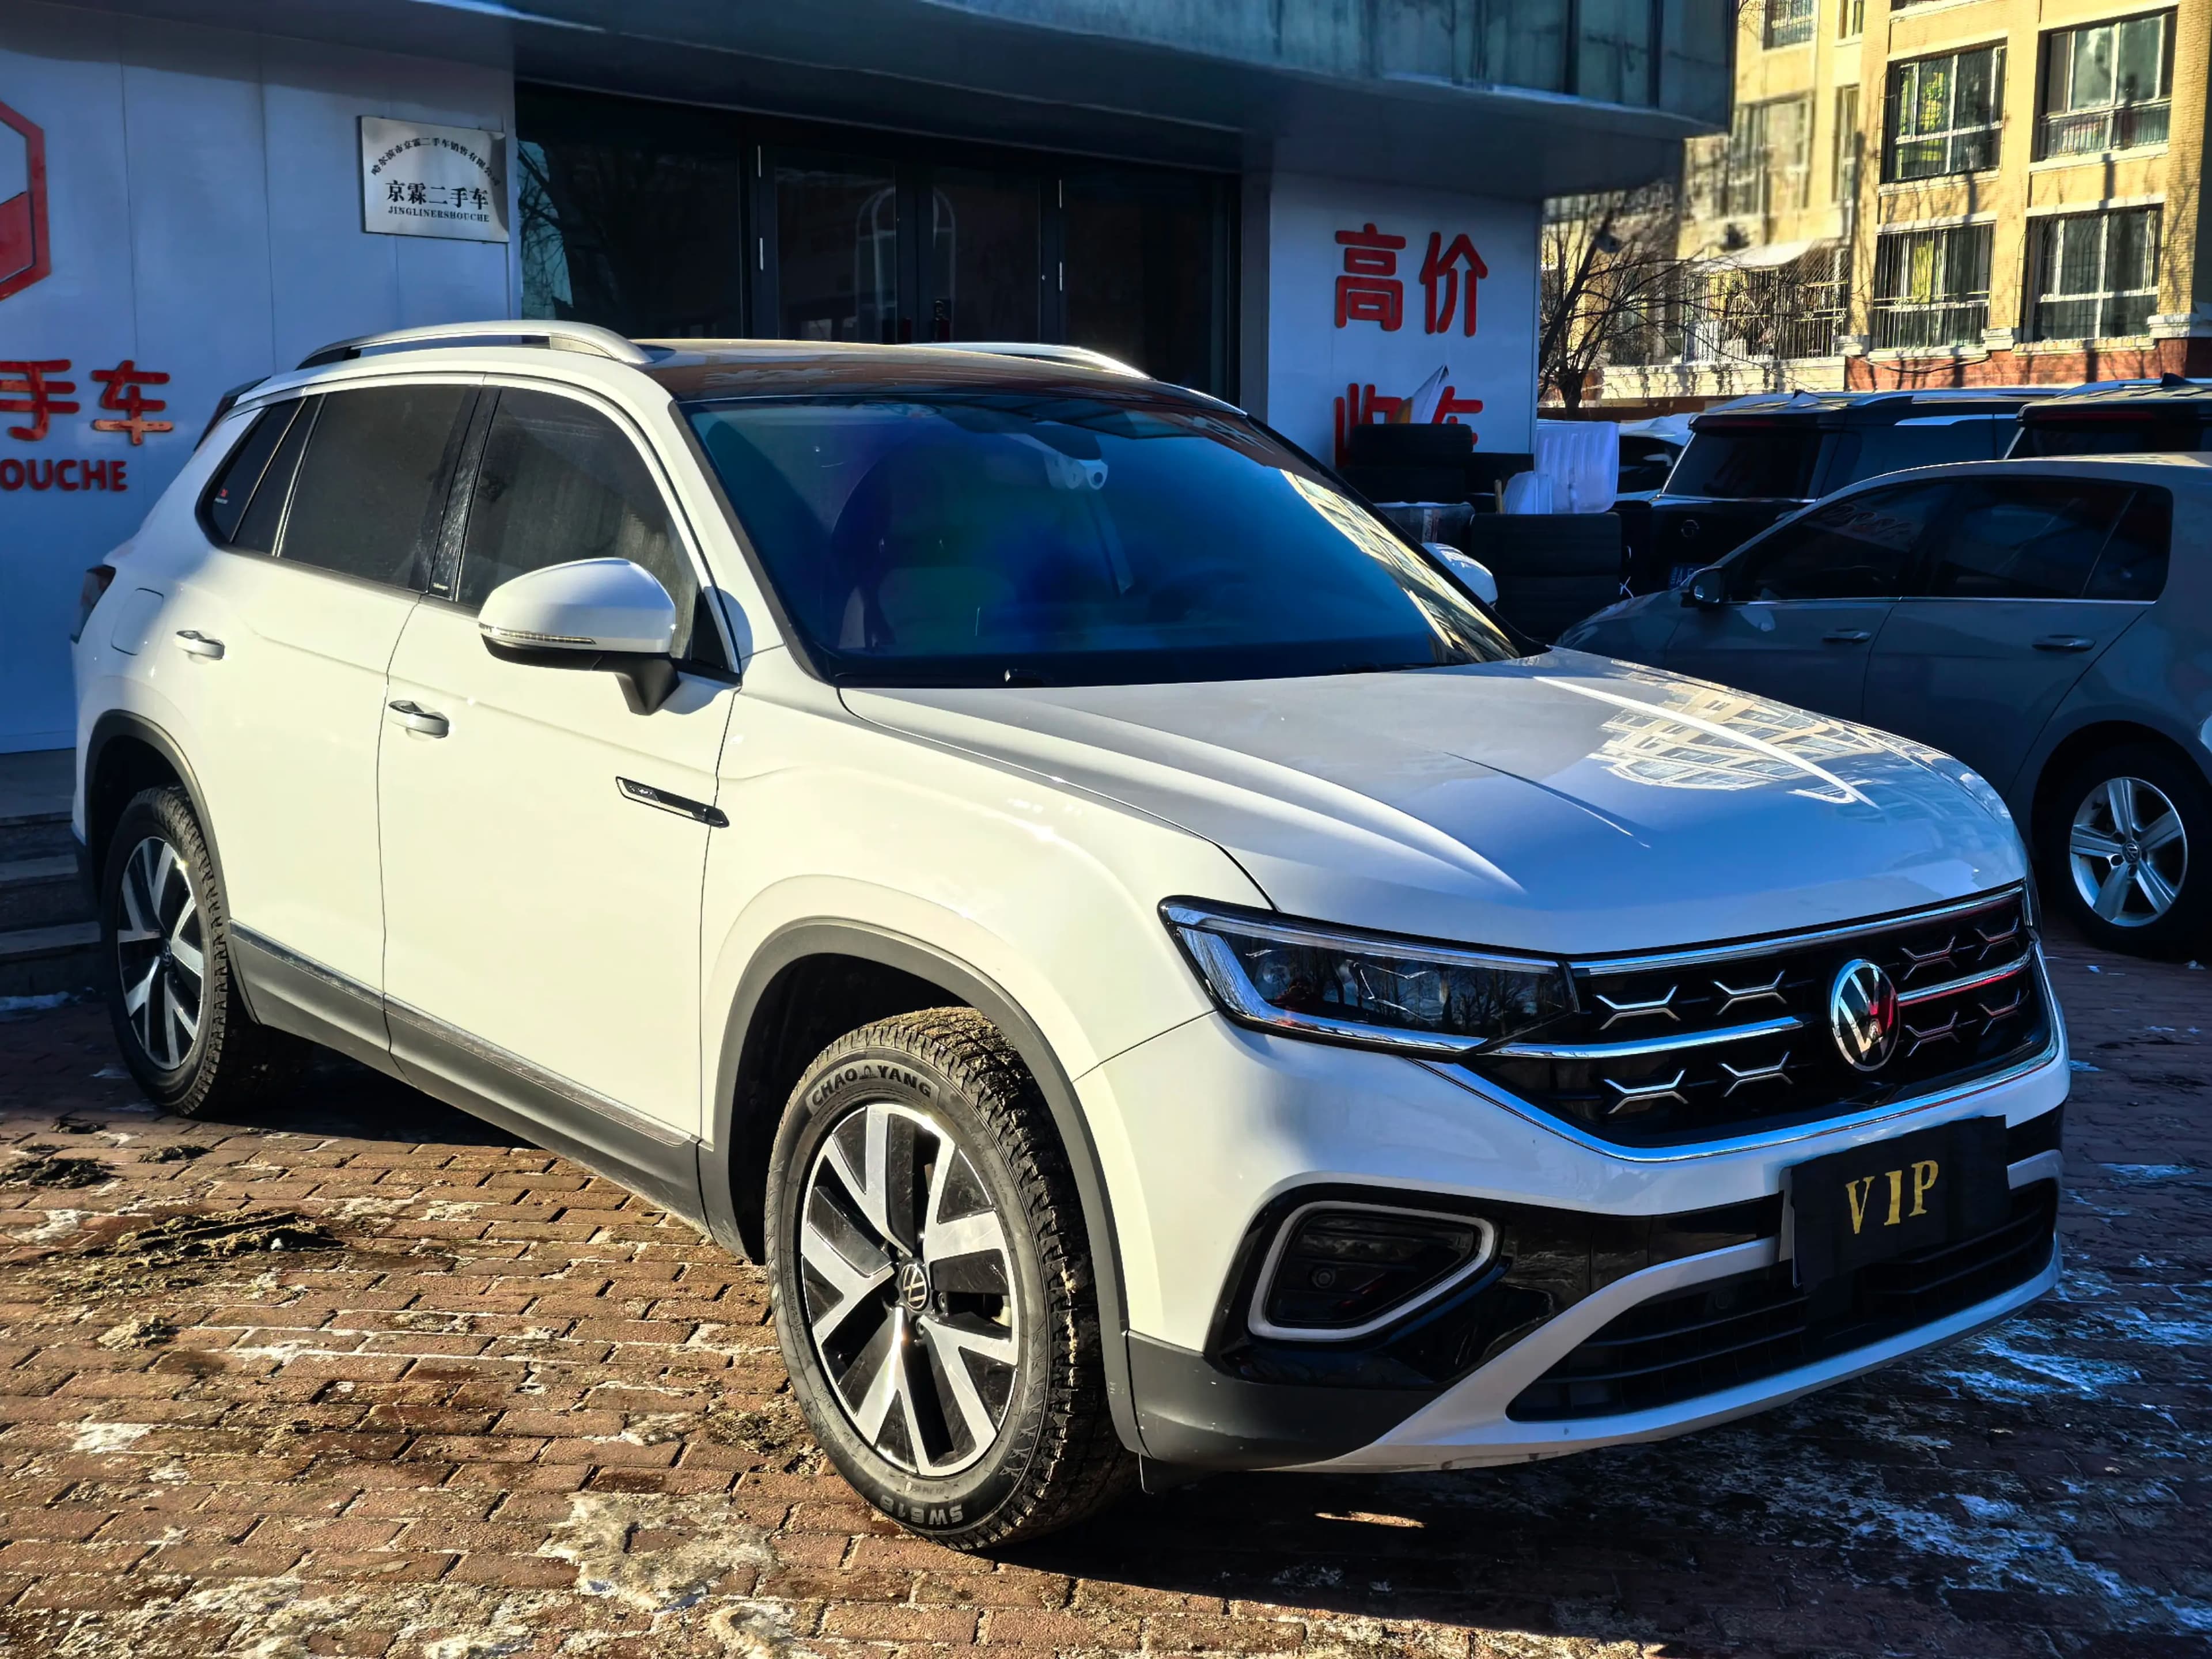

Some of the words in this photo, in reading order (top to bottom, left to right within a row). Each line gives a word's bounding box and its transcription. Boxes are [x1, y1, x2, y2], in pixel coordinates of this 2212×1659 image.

[385, 180, 489, 210] 京霖二手车
[388, 206, 490, 222] JINGLINERSHOUCHE
[1335, 222, 1488, 338] 高价
[0, 459, 128, 491] OUCHE
[812, 1067, 858, 1106] CHAO
[877, 1065, 931, 1099] YANG
[1845, 1160, 1940, 1235] VIP
